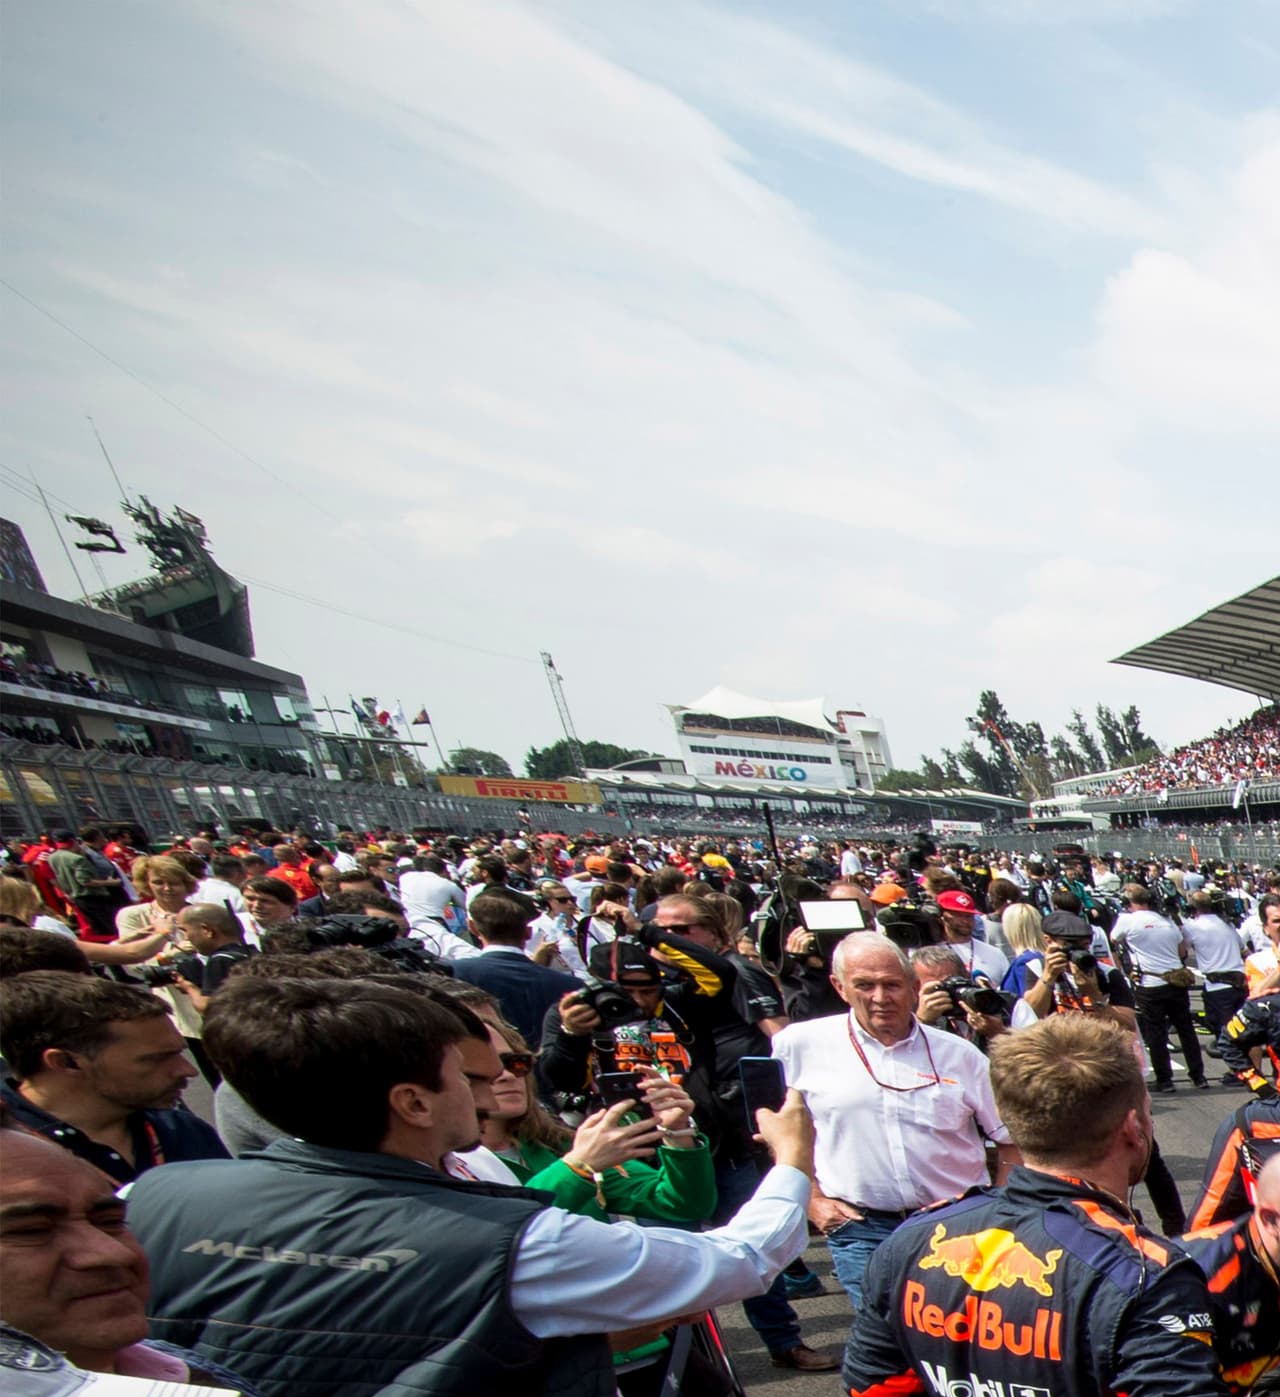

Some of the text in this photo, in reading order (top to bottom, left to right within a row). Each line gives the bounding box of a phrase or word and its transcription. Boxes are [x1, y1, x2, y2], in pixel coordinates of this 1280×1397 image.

[475, 780, 569, 800] PIRELLI
[904, 1280, 1063, 1363] Red Bull
[1188, 1313, 1214, 1329] AT&
